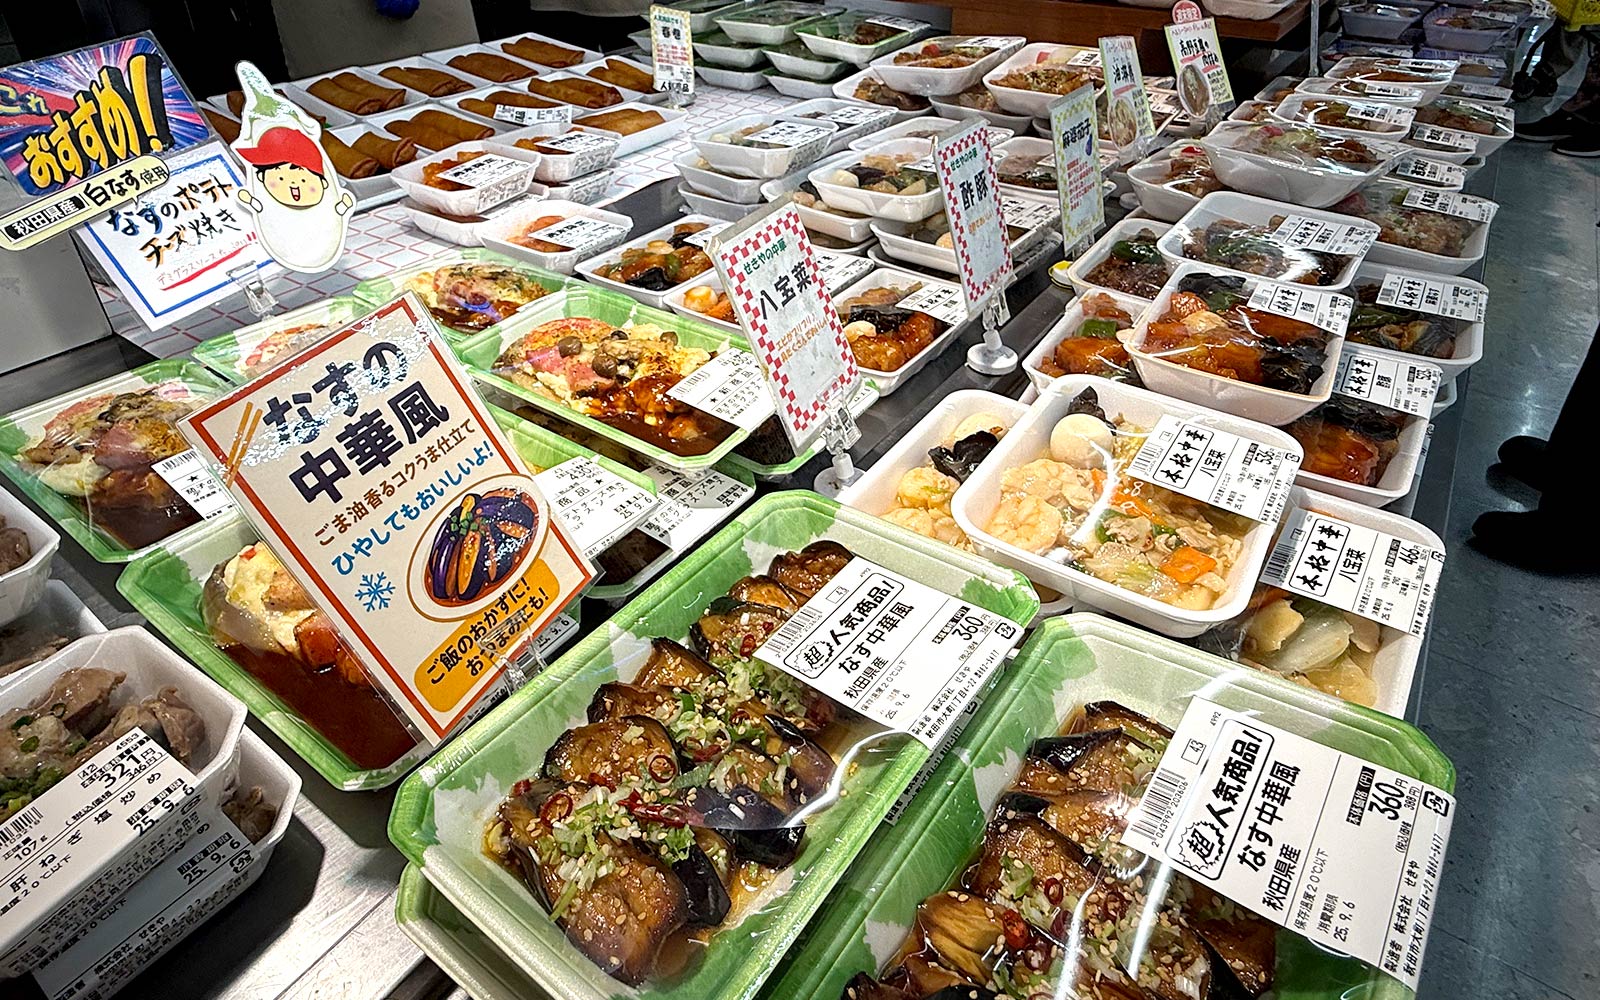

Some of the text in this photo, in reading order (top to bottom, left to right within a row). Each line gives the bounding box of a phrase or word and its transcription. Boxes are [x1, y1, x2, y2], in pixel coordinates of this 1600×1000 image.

[14, 197, 79, 237] 秋田県産
[105, 174, 234, 237] なすのポテト
[959, 169, 989, 211] 酢豚
[743, 238, 787, 275] せきやの中華
[760, 260, 813, 320] 八宝菜
[263, 342, 406, 445] なすの
[1345, 358, 1374, 395] 本格中華
[288, 380, 450, 506] 中華風
[1160, 428, 1209, 483] 本格中華
[1199, 447, 1228, 479] 八宝菜
[314, 418, 478, 548] ごま油香るコクうま仕立て
[331, 441, 495, 577] ひやしてもおいしいよ!
[556, 486, 590, 508] 商品
[1296, 525, 1346, 592] 本格中華
[1338, 547, 1367, 584] 八宝菜
[426, 577, 531, 686] ご飯のおかずに!
[806, 646, 829, 670] 超
[837, 600, 915, 676] なす中華風
[842, 656, 890, 700] 秋田県産
[931, 686, 956, 714] 株式会社
[1190, 740, 1205, 754] 43
[1171, 780, 1188, 807] 203606
[1187, 729, 1264, 864] 超 人気商品!
[1236, 759, 1301, 872] なす中華風
[1261, 842, 1302, 912] 秋田県産
[1316, 893, 1339, 934] 消費期限
[1382, 859, 1421, 974] 製造者 株式会社 せきや
[1401, 877, 1433, 978] 秋田市大町1丁目4-22
